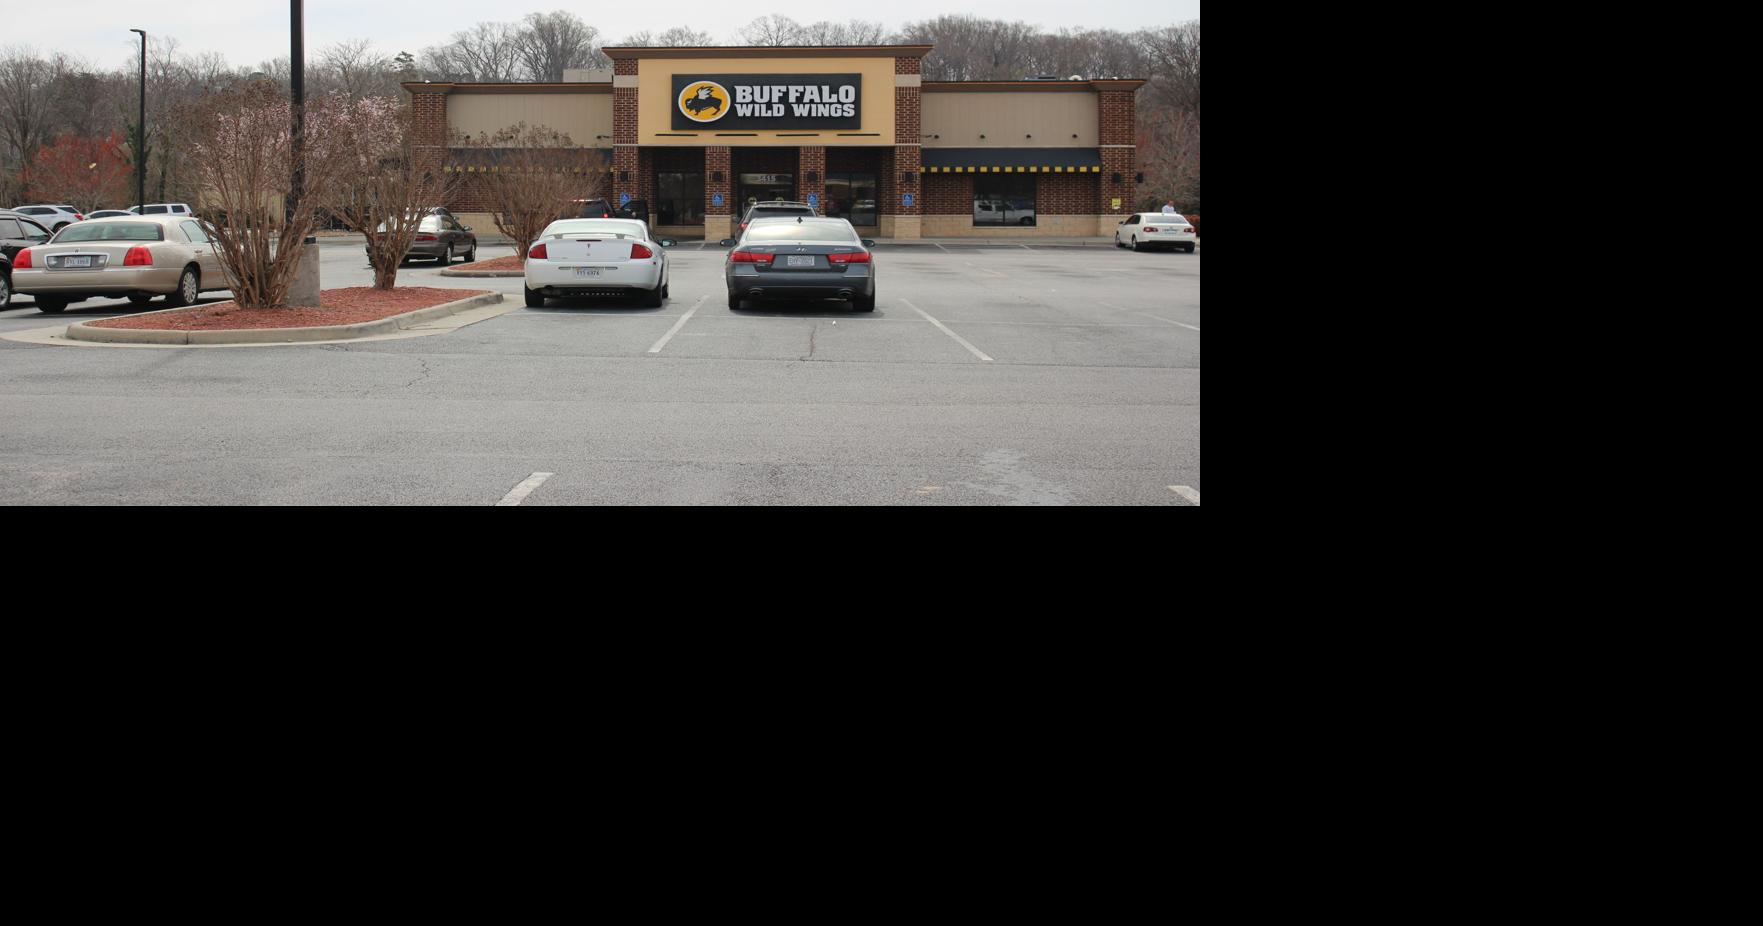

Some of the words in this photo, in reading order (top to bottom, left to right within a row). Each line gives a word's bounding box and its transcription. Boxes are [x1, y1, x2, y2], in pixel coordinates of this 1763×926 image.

[734, 85, 856, 103] BUFFALO
[734, 103, 785, 117] WILD
[791, 103, 856, 117] WINGS
